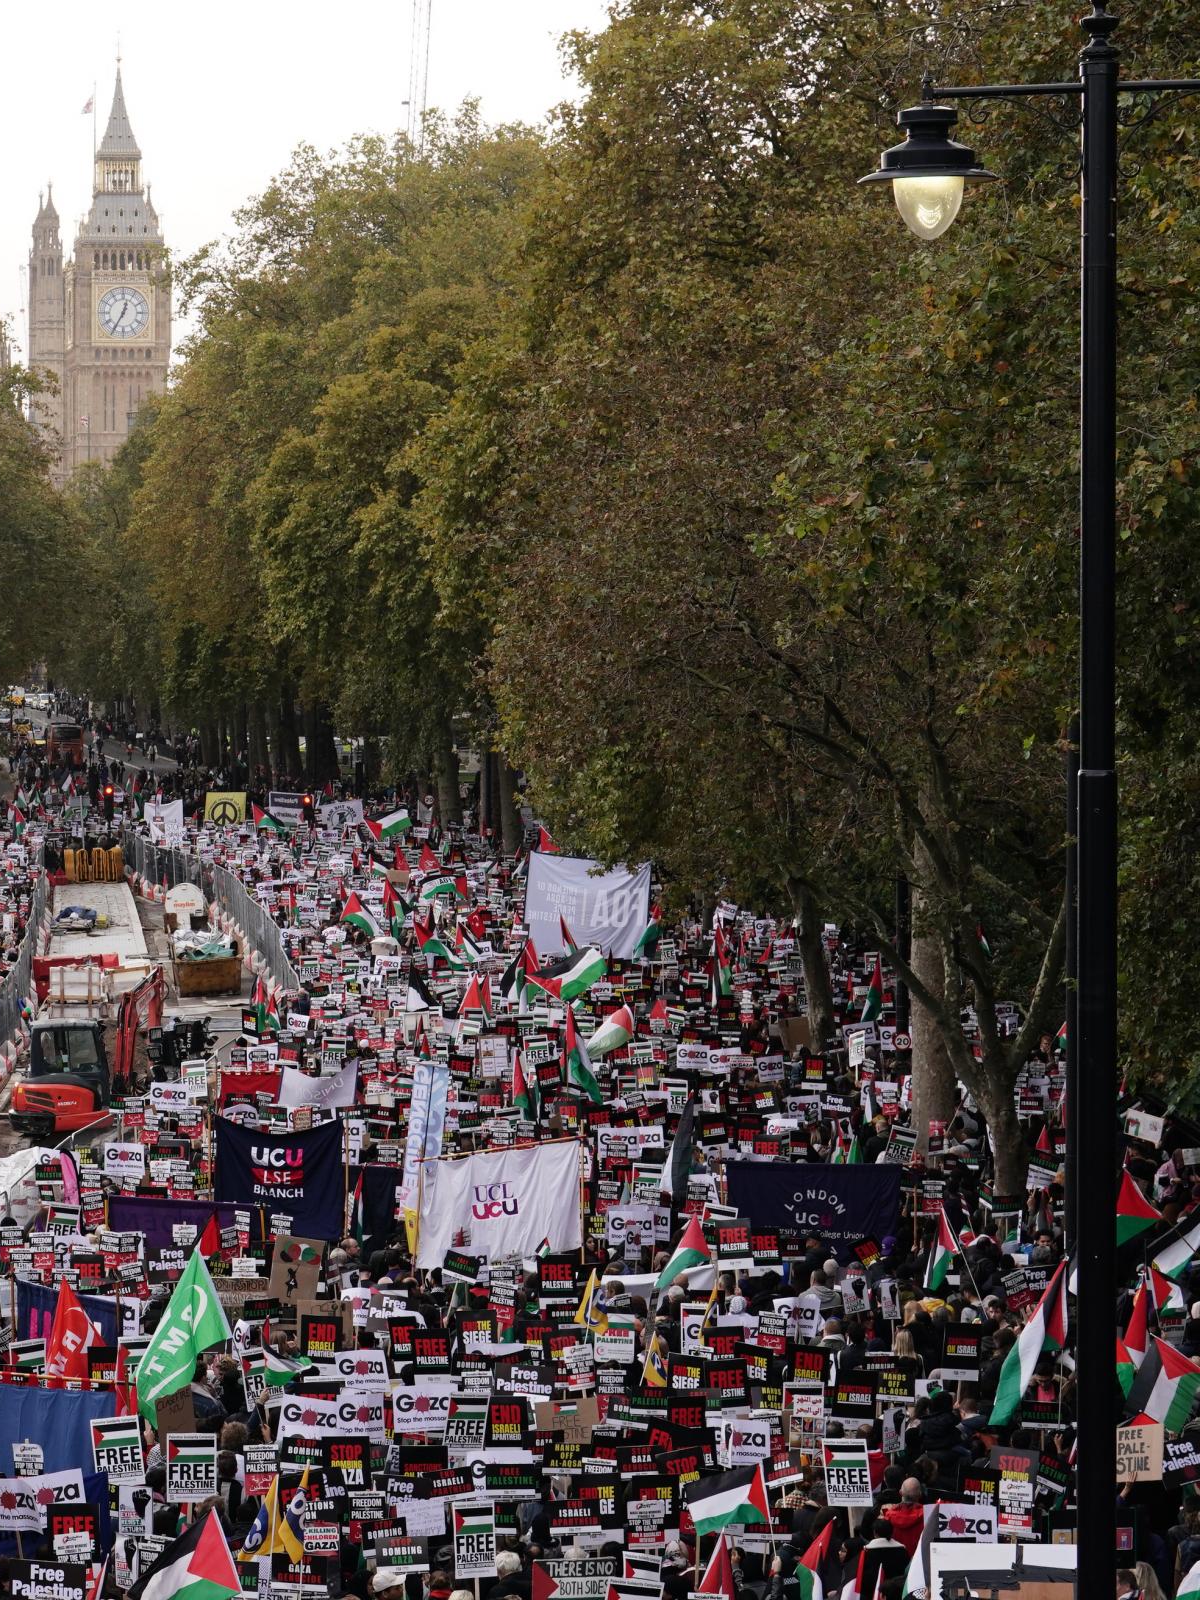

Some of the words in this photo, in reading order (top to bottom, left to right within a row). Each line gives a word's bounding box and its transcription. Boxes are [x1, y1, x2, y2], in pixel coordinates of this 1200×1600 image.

[375, 959, 400, 969] Gza
[287, 1016, 307, 1027] Gza
[896, 1036, 909, 1046] 20
[525, 1050, 548, 1059] FREE
[678, 1048, 708, 1060] Gza
[758, 1062, 783, 1072] Gza
[182, 1076, 205, 1087] FREE
[152, 1086, 186, 1100] Gza
[826, 1096, 844, 1104] Free
[106, 1147, 142, 1162] Gza
[251, 1146, 304, 1168] UCU
[263, 1170, 292, 1184] LSE
[252, 1184, 304, 1198] BRANCH
[474, 1184, 514, 1201] UCL
[783, 1189, 846, 1215] LONDON
[720, 1227, 748, 1242] FREE
[817, 1229, 841, 1239] ollege
[843, 1231, 864, 1240] Union
[719, 1241, 749, 1250] PALESTINE
[160, 1249, 184, 1259] Free
[541, 1264, 572, 1281] FREE
[541, 1280, 573, 1289] PALESTINE
[476, 1320, 491, 1332] THE
[760, 1317, 785, 1326] FREEDOM
[308, 1323, 336, 1341] END
[462, 1330, 492, 1344] SIEGE
[759, 1327, 785, 1336] PALESTINE
[307, 1341, 335, 1351] ISRAELI
[414, 1338, 447, 1356] FREE
[947, 1344, 956, 1354] ON
[956, 1344, 977, 1354] ISRAEL
[416, 1355, 449, 1365] PALESTINE
[795, 1351, 823, 1371] END
[338, 1358, 384, 1376] Gza
[510, 1366, 538, 1381] Free
[710, 1370, 744, 1388] FREE
[794, 1369, 822, 1379] ISRAELI
[883, 1372, 906, 1381] HANDS
[599, 1375, 624, 1384] FREEDOM
[672, 1377, 700, 1389] SIEGE
[496, 1379, 552, 1394] Palestine
[598, 1385, 625, 1394] PALESTINE
[878, 1386, 908, 1396] AL-AQSA
[837, 1392, 848, 1403] ON
[849, 1392, 872, 1403] ISRAEL
[338, 1403, 382, 1422] Gza
[491, 1404, 521, 1422] END
[445, 1419, 484, 1436] FREE
[492, 1423, 521, 1434] ISRAELI
[444, 1435, 483, 1444] PALESTINE
[492, 1433, 521, 1441] APARTHEID
[1118, 1429, 1143, 1442] FREE
[330, 1444, 363, 1460] STOP
[554, 1444, 581, 1452] HANDS
[1117, 1442, 1151, 1455] PALE-
[1166, 1442, 1194, 1458] Free
[96, 1446, 140, 1467] FREE
[247, 1451, 275, 1461] FREEDOM
[560, 1451, 574, 1459] OFF
[96, 1463, 143, 1473] PALESTINE
[246, 1463, 278, 1473] PALESTINE
[550, 1459, 582, 1468] AL-AQSA
[774, 1460, 790, 1471] GAZA
[998, 1455, 1031, 1472] STOP
[1115, 1455, 1150, 1475] STINE
[1161, 1454, 1200, 1473] Palestin
[168, 1463, 215, 1480] FREE
[499, 1467, 520, 1476] FREE
[826, 1468, 868, 1485] FREE
[168, 1480, 215, 1488] PALESTINE
[433, 1476, 464, 1488] ISRAELI
[487, 1476, 534, 1485] PALESTINE
[827, 1484, 870, 1494] PALESTINE
[352, 1498, 382, 1508] FREEDOM
[351, 1510, 384, 1520] PALESTINE
[558, 1508, 591, 1518] ISRAELI
[304, 1542, 337, 1550] GAZA
[456, 1534, 495, 1553] FREE
[382, 1545, 422, 1557] BOMBING
[391, 1555, 414, 1564] GAZA
[457, 1553, 495, 1563] PALESTINE
[30, 1563, 65, 1582] Free
[549, 1561, 585, 1577] THERE
[586, 1561, 596, 1576] IS
[596, 1561, 614, 1576] NO
[11, 1579, 83, 1600] Palestine
